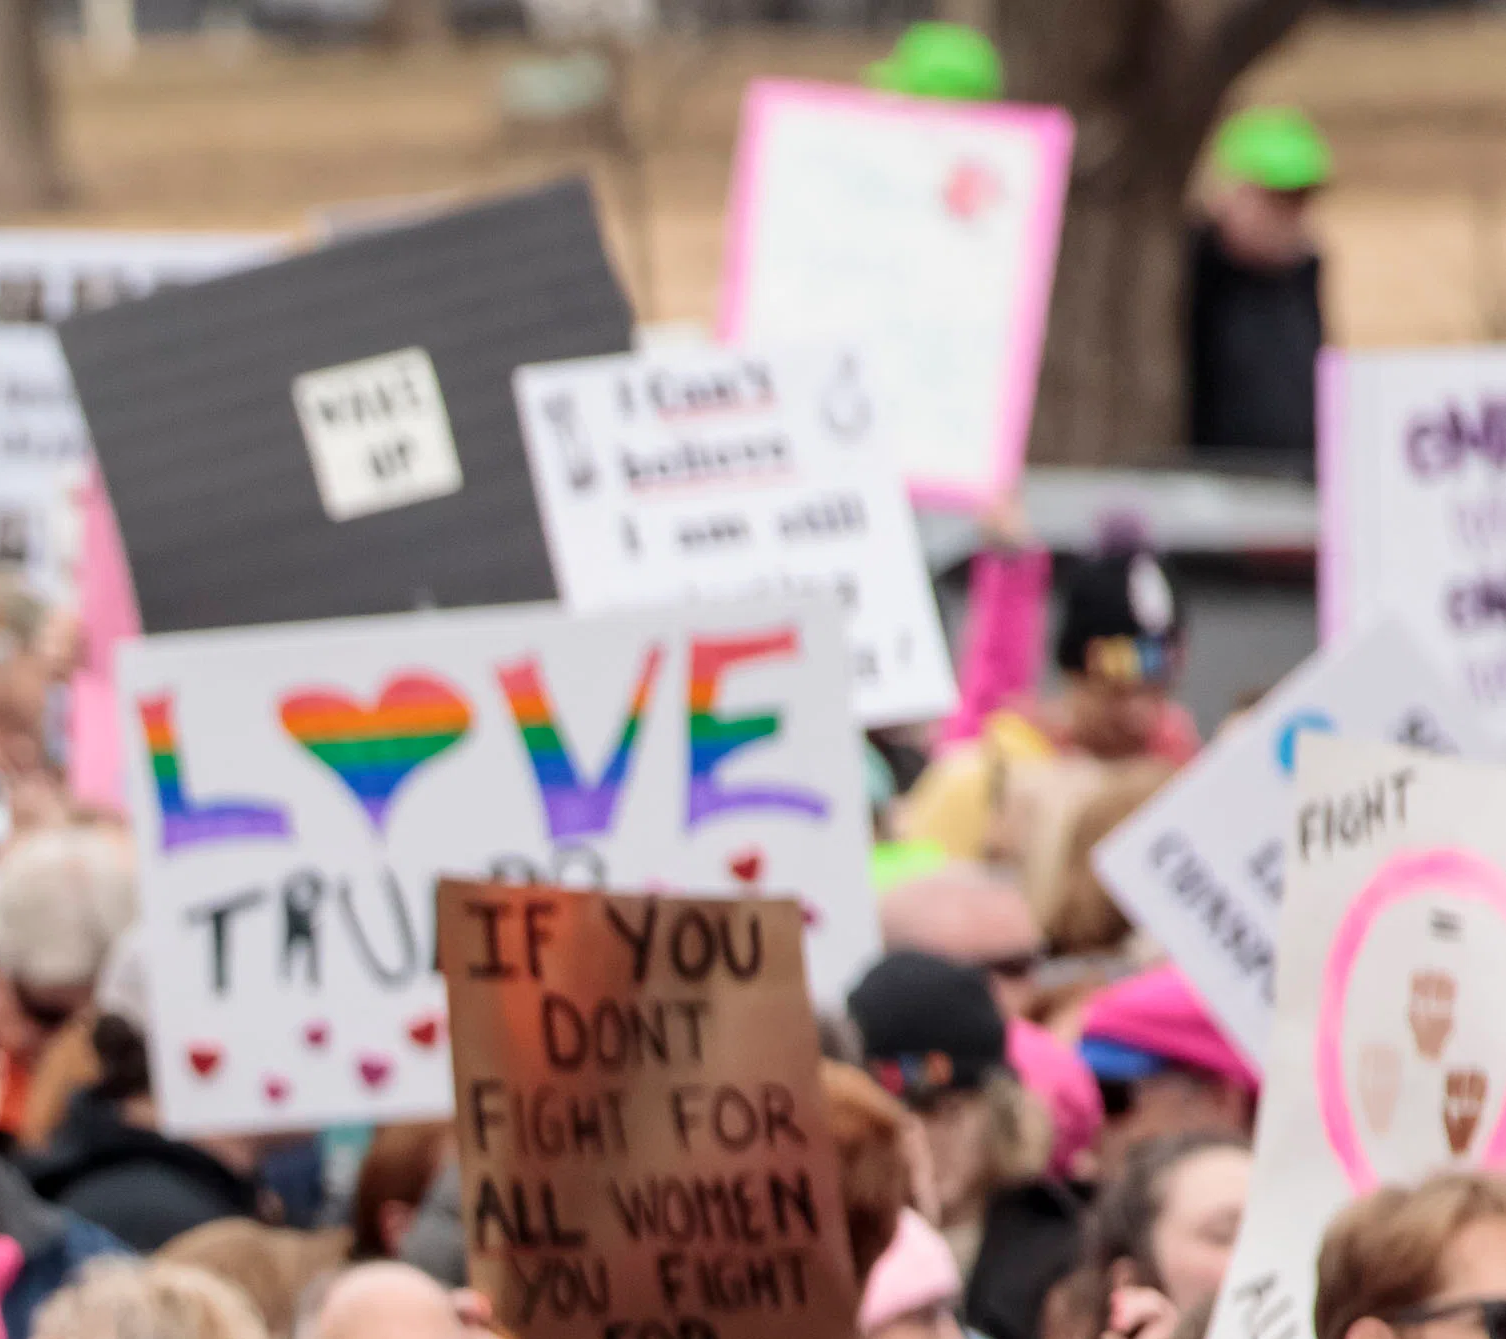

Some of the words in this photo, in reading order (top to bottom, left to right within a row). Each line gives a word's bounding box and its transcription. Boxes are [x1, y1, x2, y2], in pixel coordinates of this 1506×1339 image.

[1295, 767, 1419, 862] FIGHT
[467, 897, 561, 982] IF
[601, 898, 764, 986] YOU
[469, 1075, 631, 1159] FIGHT
[674, 1082, 809, 1155] FOR
[477, 1180, 586, 1250] ALL
[612, 1174, 821, 1245] WOMEN
[511, 1264, 613, 1328] YOU
[661, 1250, 810, 1314] FIGHT
